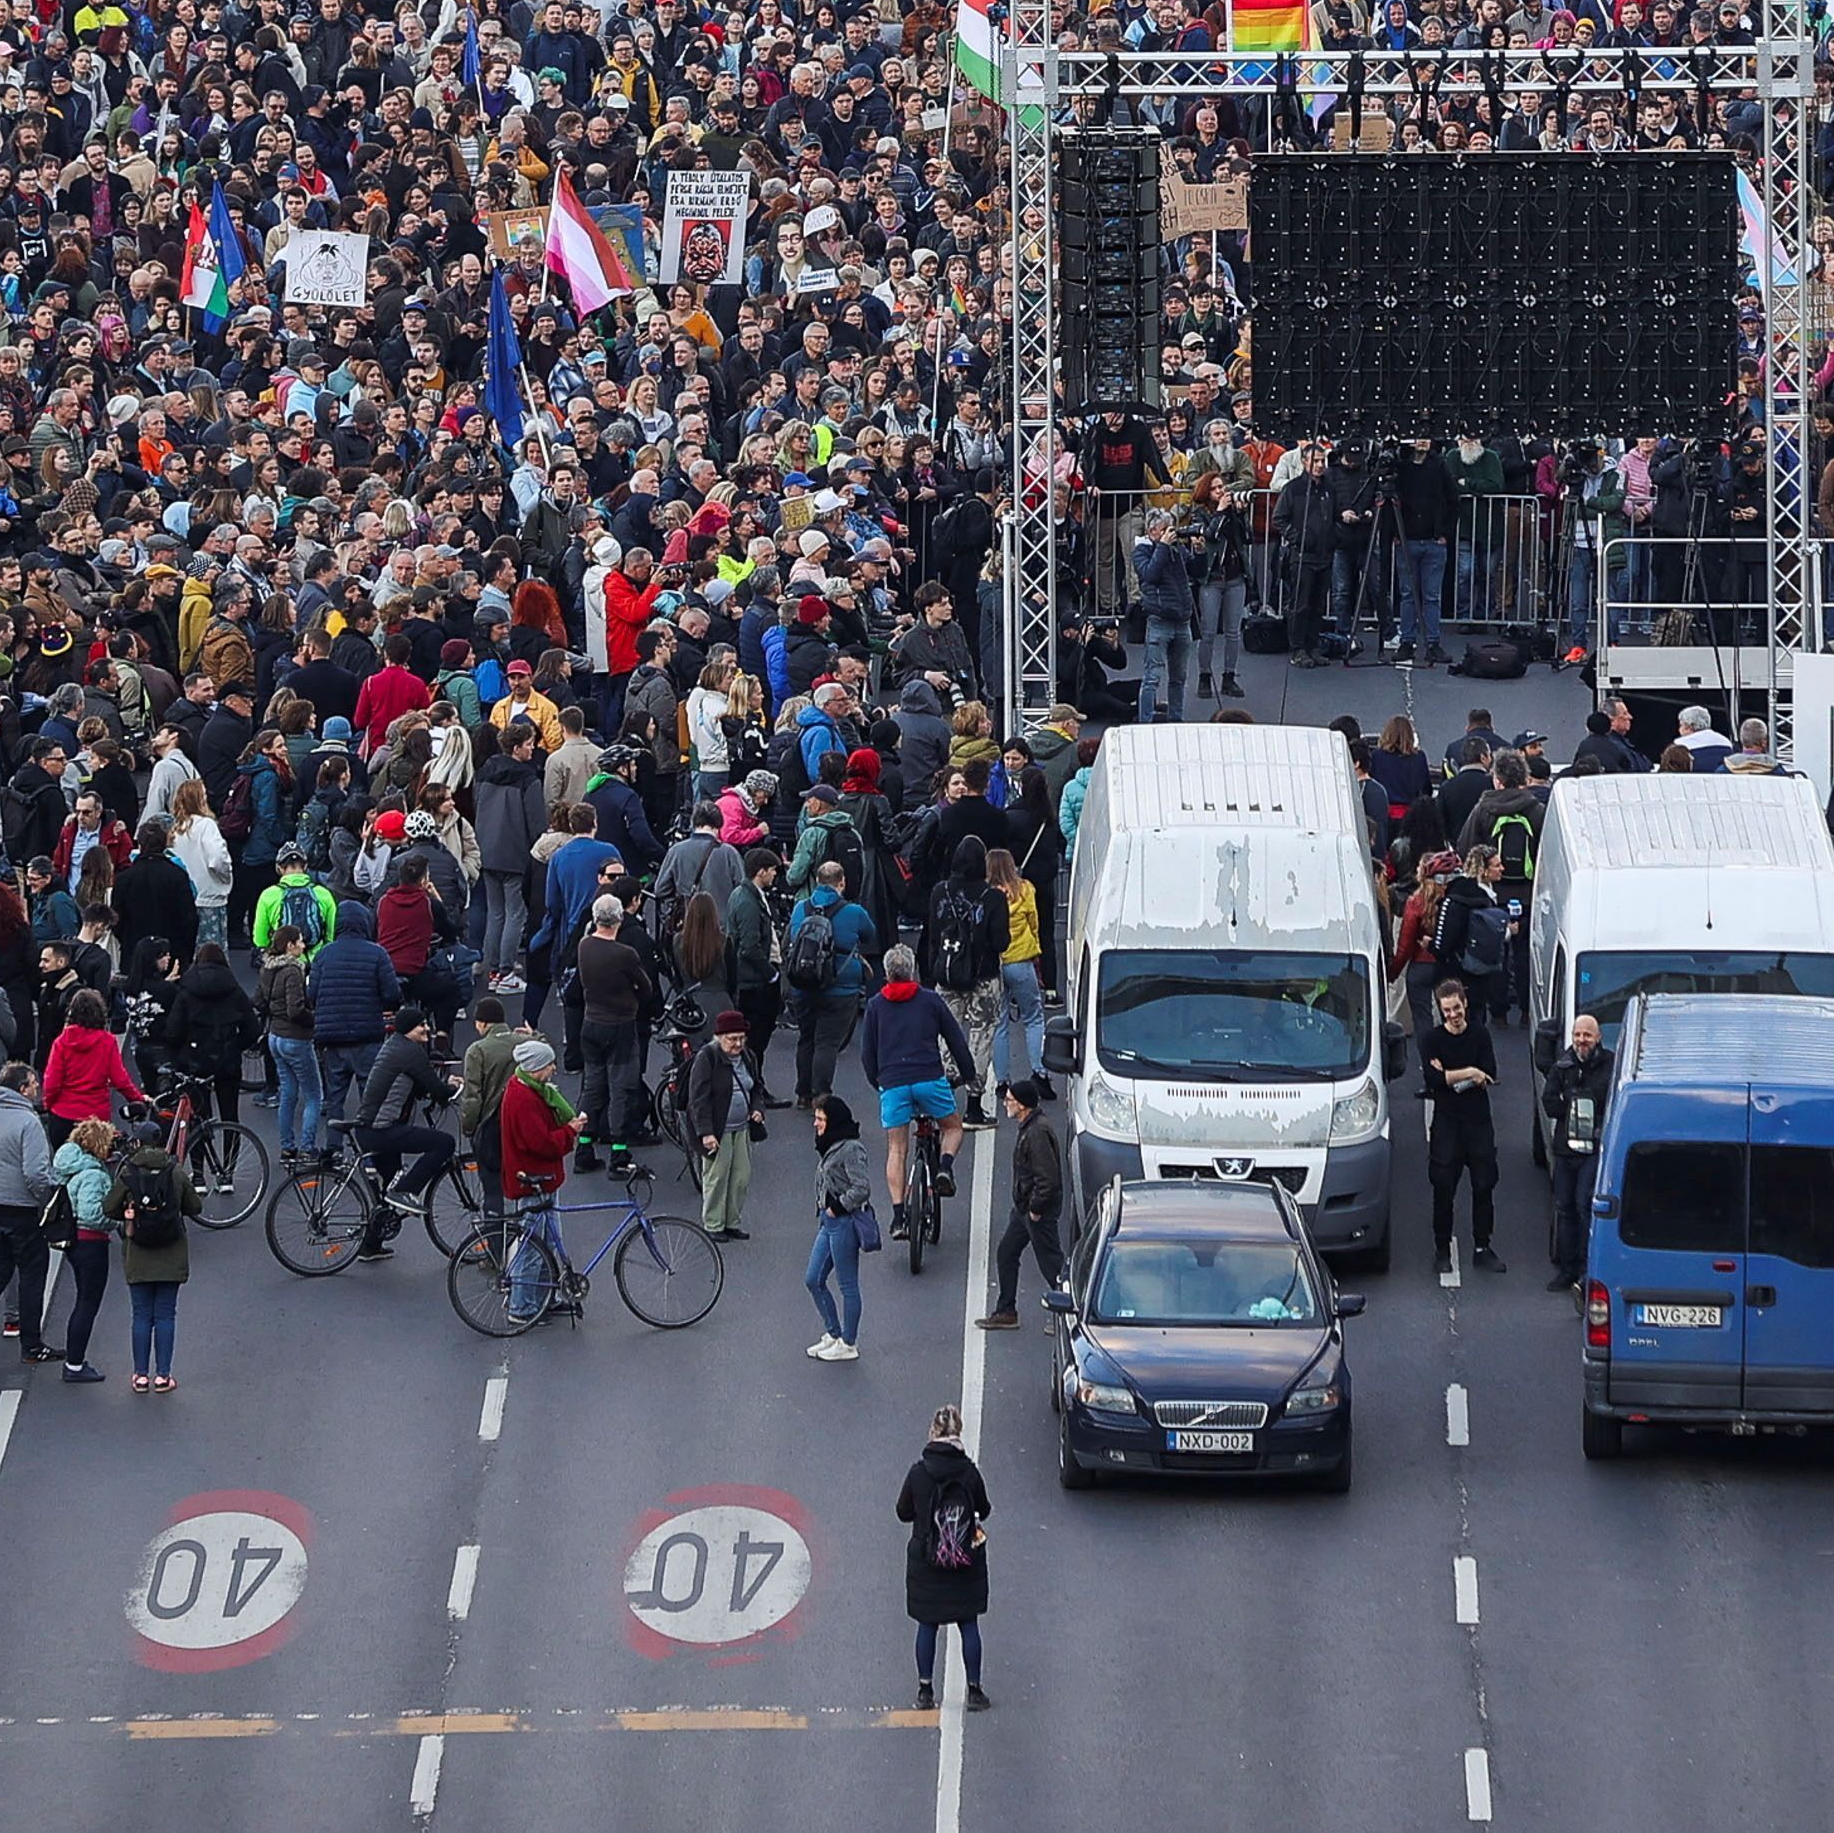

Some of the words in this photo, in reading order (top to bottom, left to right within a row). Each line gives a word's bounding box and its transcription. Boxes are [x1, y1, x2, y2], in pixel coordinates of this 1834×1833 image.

[670, 173, 677, 183] A
[1647, 1307, 1717, 1325] NVG-226
[1179, 1433, 1250, 1450] NXD-002
[145, 1537, 284, 1620] 40
[651, 1531, 785, 1613] 40
